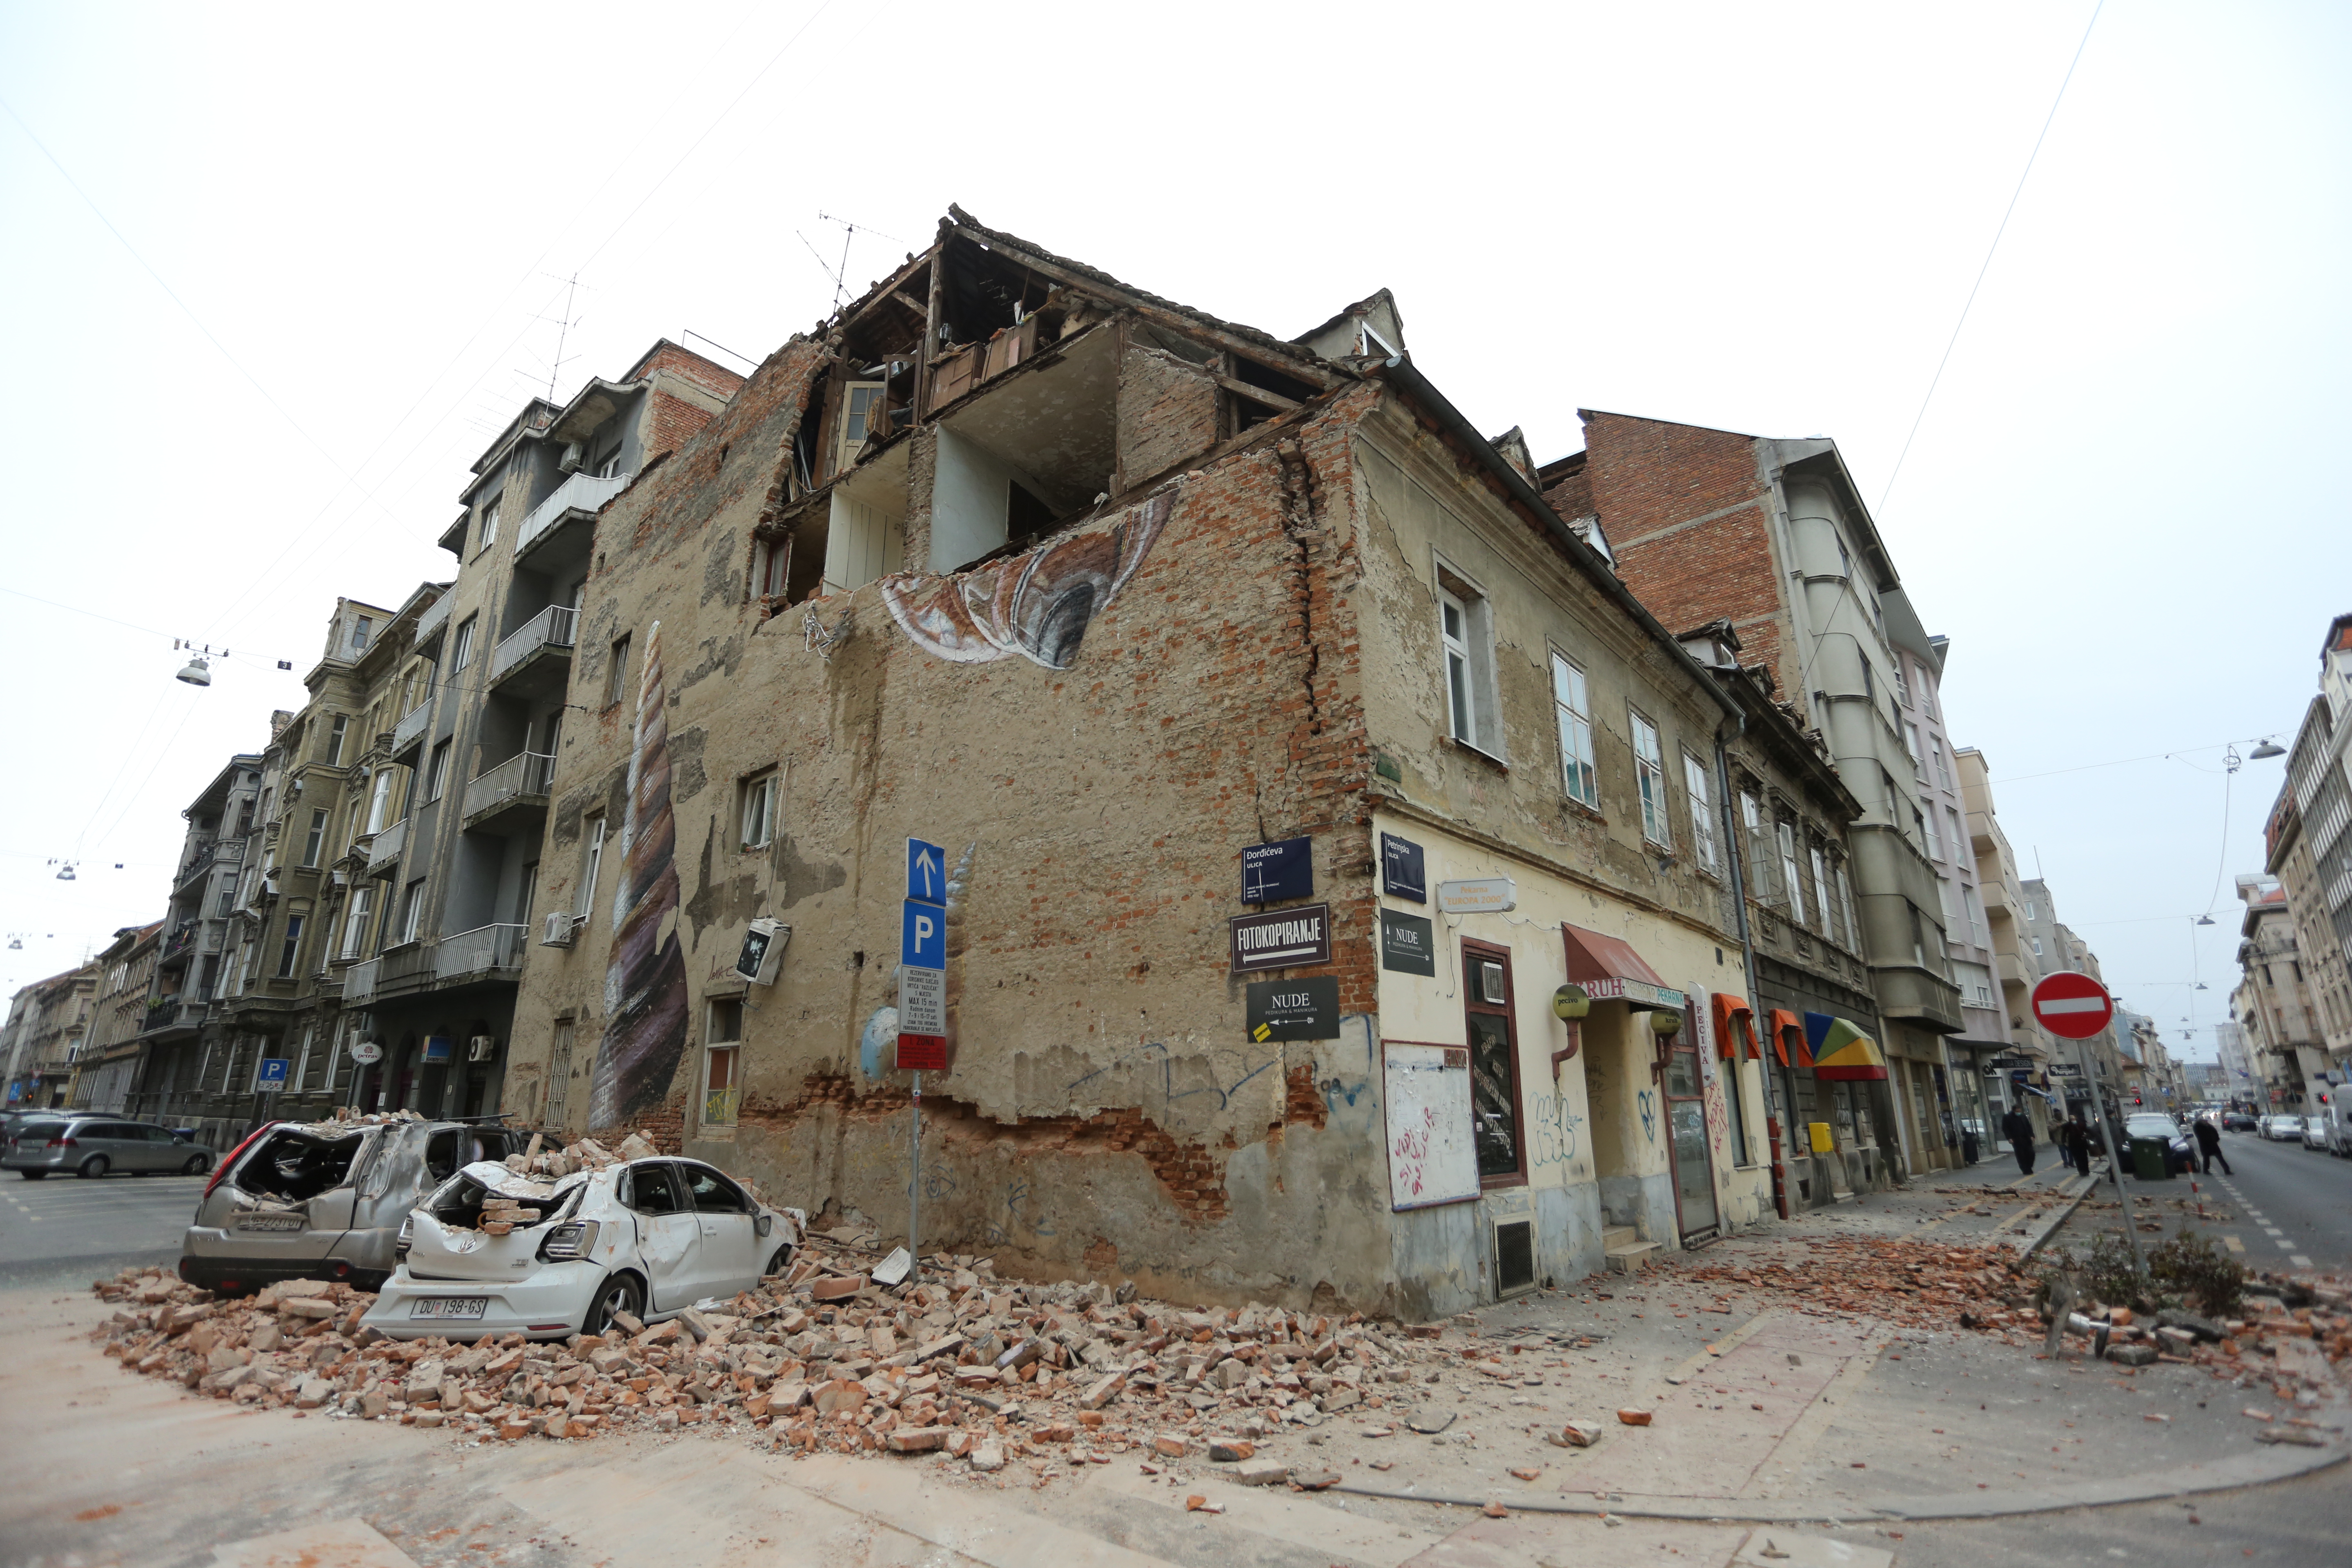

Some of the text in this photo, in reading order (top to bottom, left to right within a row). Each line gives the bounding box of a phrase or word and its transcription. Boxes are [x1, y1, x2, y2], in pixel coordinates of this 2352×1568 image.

[1247, 847, 1283, 860] Đorđićeva
[1388, 839, 1410, 854] Petrinjska
[914, 915, 933, 953] P
[1238, 918, 1321, 951] FOTOKOPIRANJE
[1396, 928, 1418, 944] NUDE
[1572, 978, 1624, 998] RUH
[1625, 980, 1684, 1006] PEKARNA PEKARNA
[909, 997, 919, 1005] MAX
[1272, 993, 1310, 1009] NUDE
[1558, 998, 1578, 1006] pecivo
[917, 1038, 934, 1046] ZONA
[1696, 1006, 1708, 1064] PECIVA
[1481, 1034, 1497, 1057] KRAFNI
[268, 1063, 280, 1076] P
[1492, 1059, 1503, 1079] KIFLI
[1474, 1065, 1511, 1117] INTEGRALNI KRUH
[420, 1300, 483, 1314] DU 198-GS
